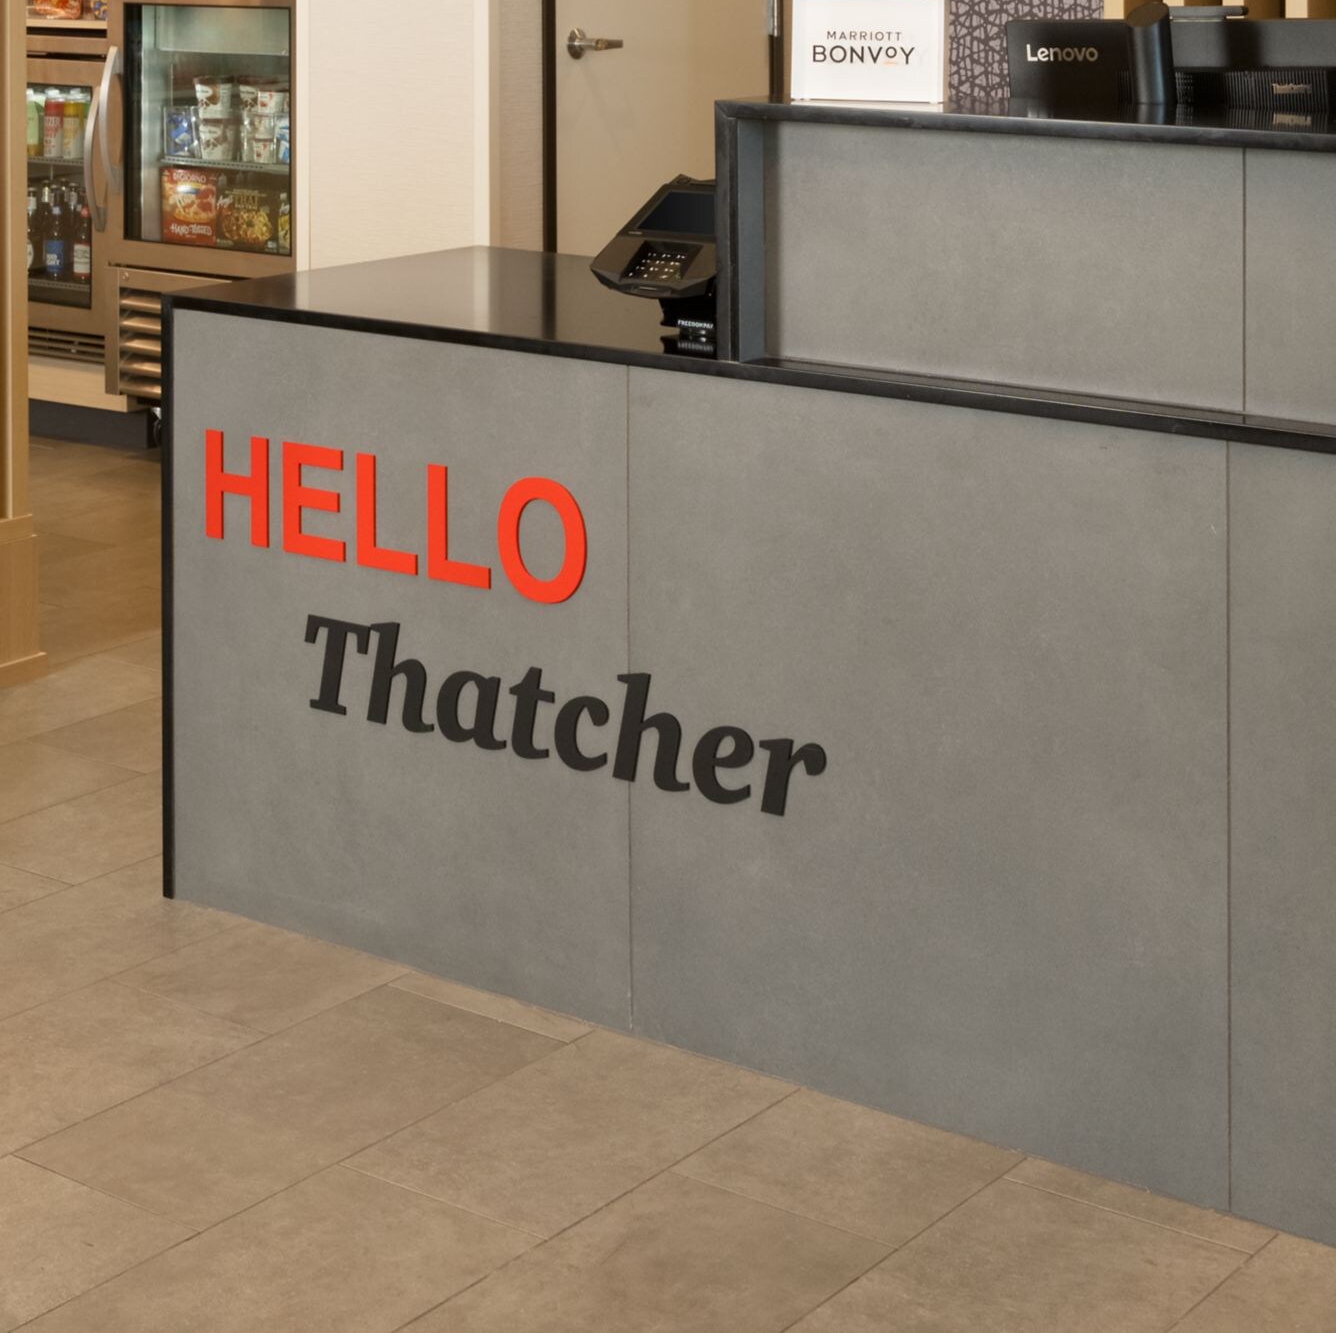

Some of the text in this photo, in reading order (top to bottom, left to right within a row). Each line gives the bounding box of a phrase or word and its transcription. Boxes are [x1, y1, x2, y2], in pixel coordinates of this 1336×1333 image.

[826, 30, 902, 42] MARRIOTT
[812, 44, 915, 65] BONVOY
[1026, 44, 1099, 63] Lenovo
[204, 428, 588, 604] HELLO
[304, 613, 827, 817] Thatcher
